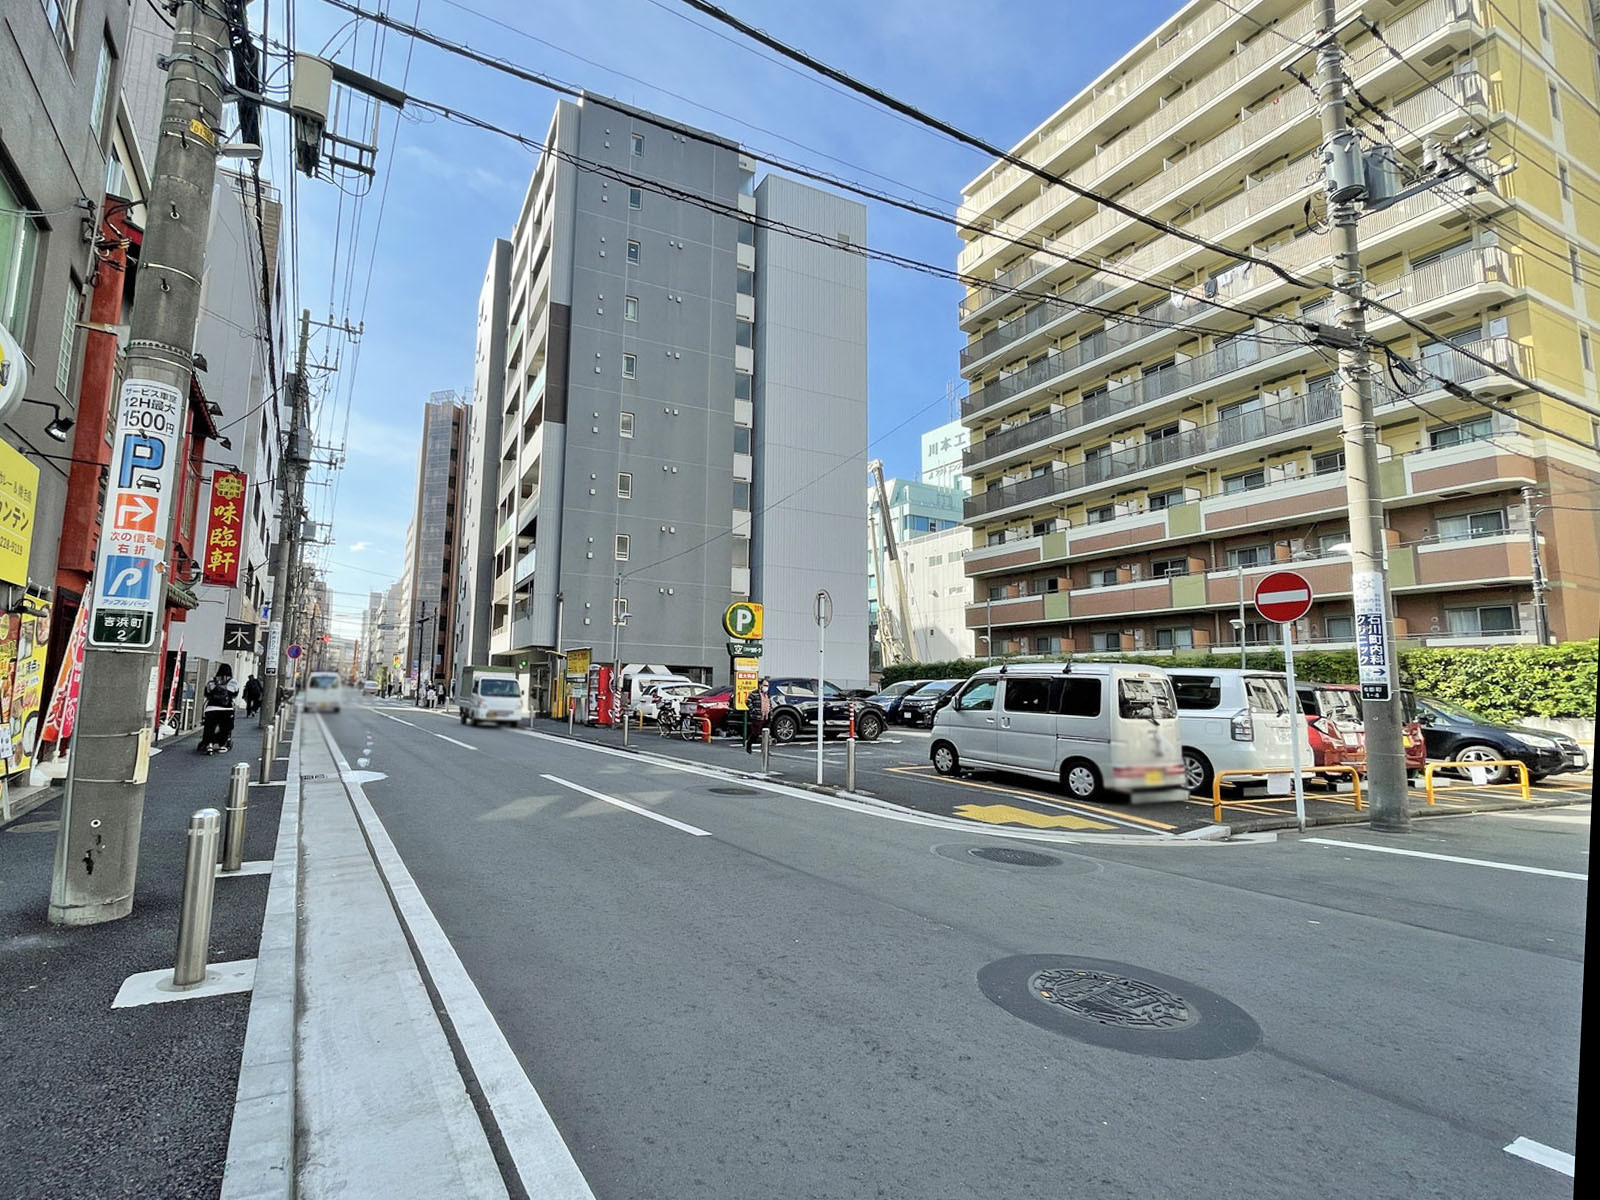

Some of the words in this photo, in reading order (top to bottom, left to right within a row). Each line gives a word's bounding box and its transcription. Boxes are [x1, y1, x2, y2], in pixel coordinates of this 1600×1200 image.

[124, 396, 176, 416] 12H最大
[122, 410, 175, 435] 1500円
[111, 532, 156, 546] 次の信号
[207, 501, 240, 574] 味臨軒
[118, 543, 147, 556] 右折
[736, 608, 752, 632] P
[116, 630, 127, 642] 2
[227, 627, 251, 648] 木
[1357, 615, 1369, 665] クリニック
[1368, 615, 1385, 665] 石川町内科
